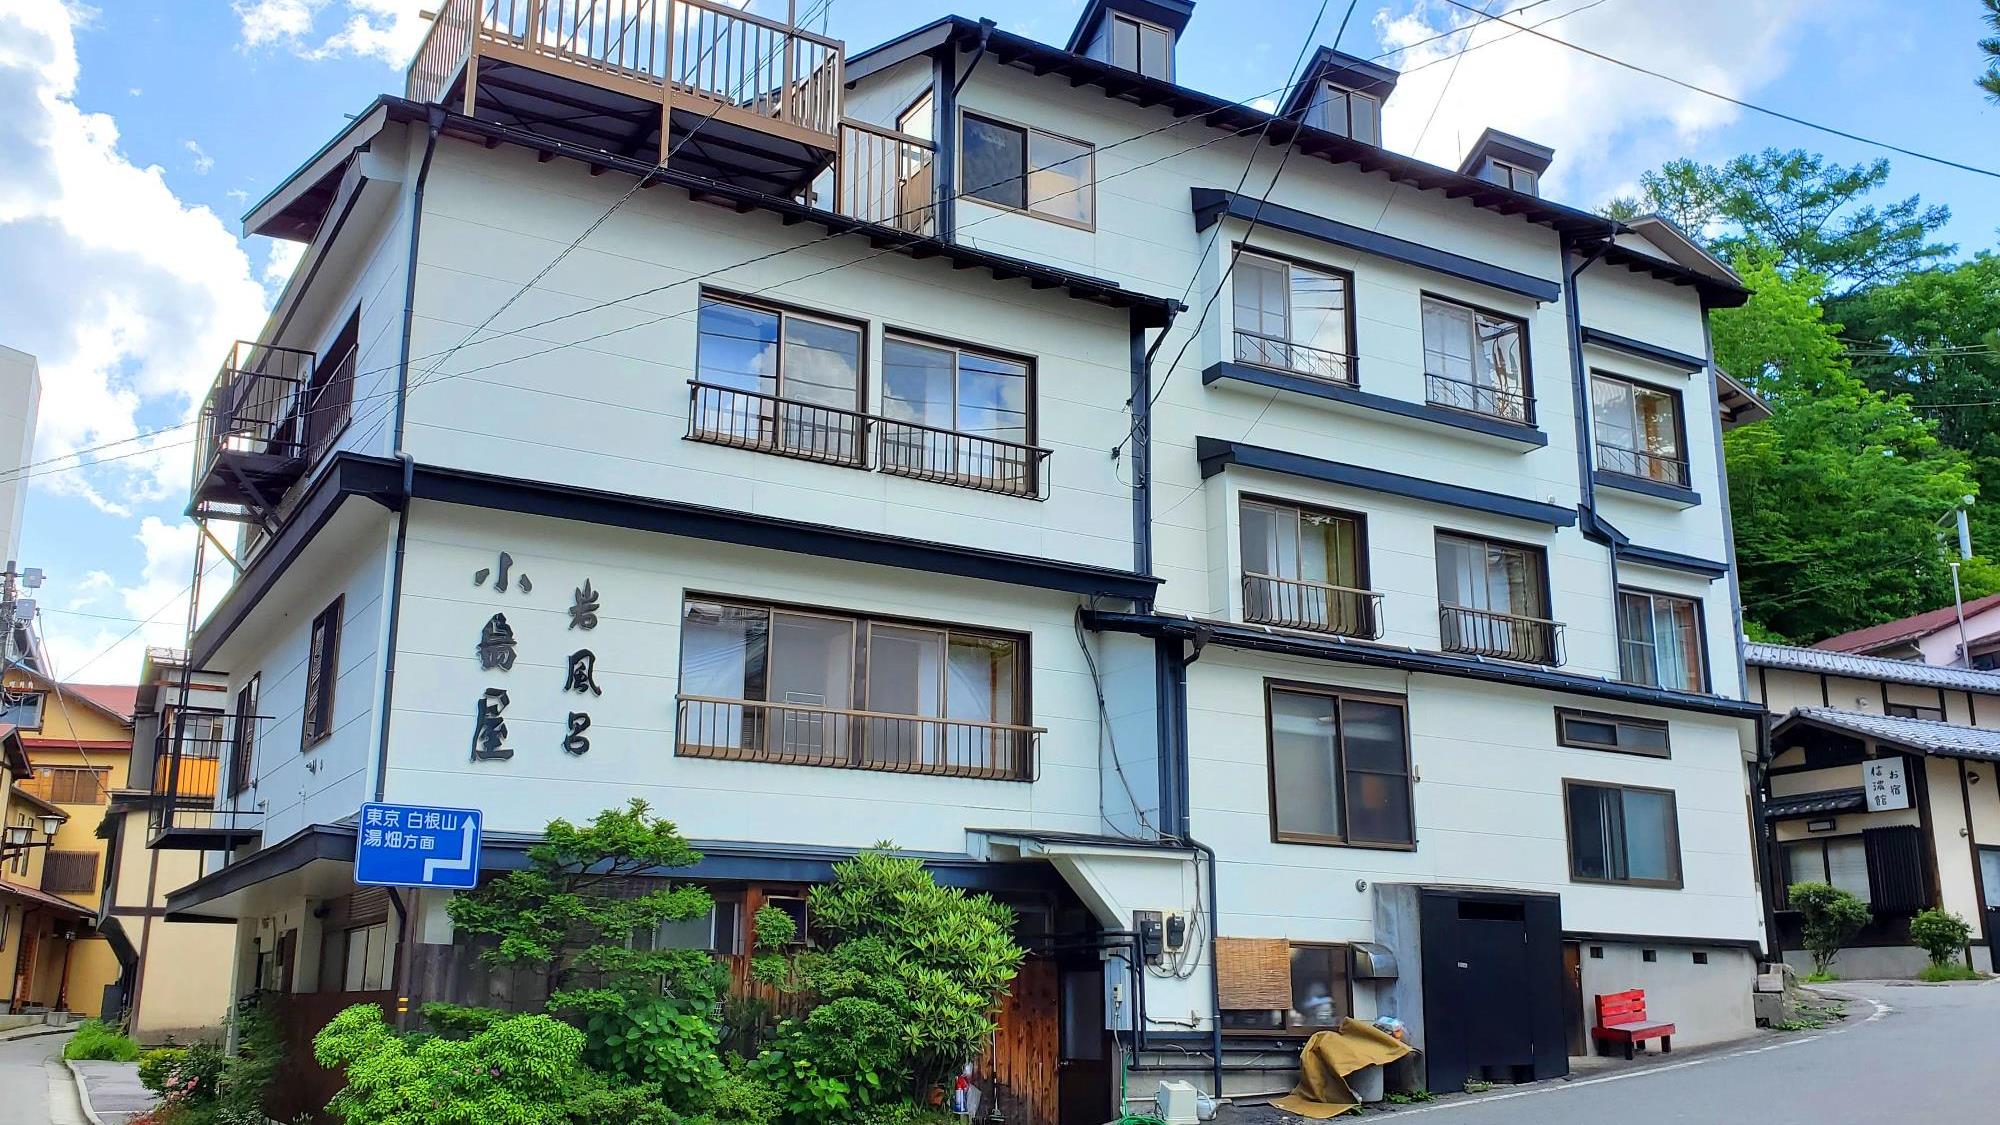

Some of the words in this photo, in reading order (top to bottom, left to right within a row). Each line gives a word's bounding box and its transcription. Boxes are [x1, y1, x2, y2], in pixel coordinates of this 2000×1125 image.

[562, 577, 602, 756] 岩風呂
[1889, 770, 1901, 796] お宿
[365, 808, 400, 828] 東京
[407, 811, 457, 831] 白根山
[363, 829, 436, 850] 湯畑方面
